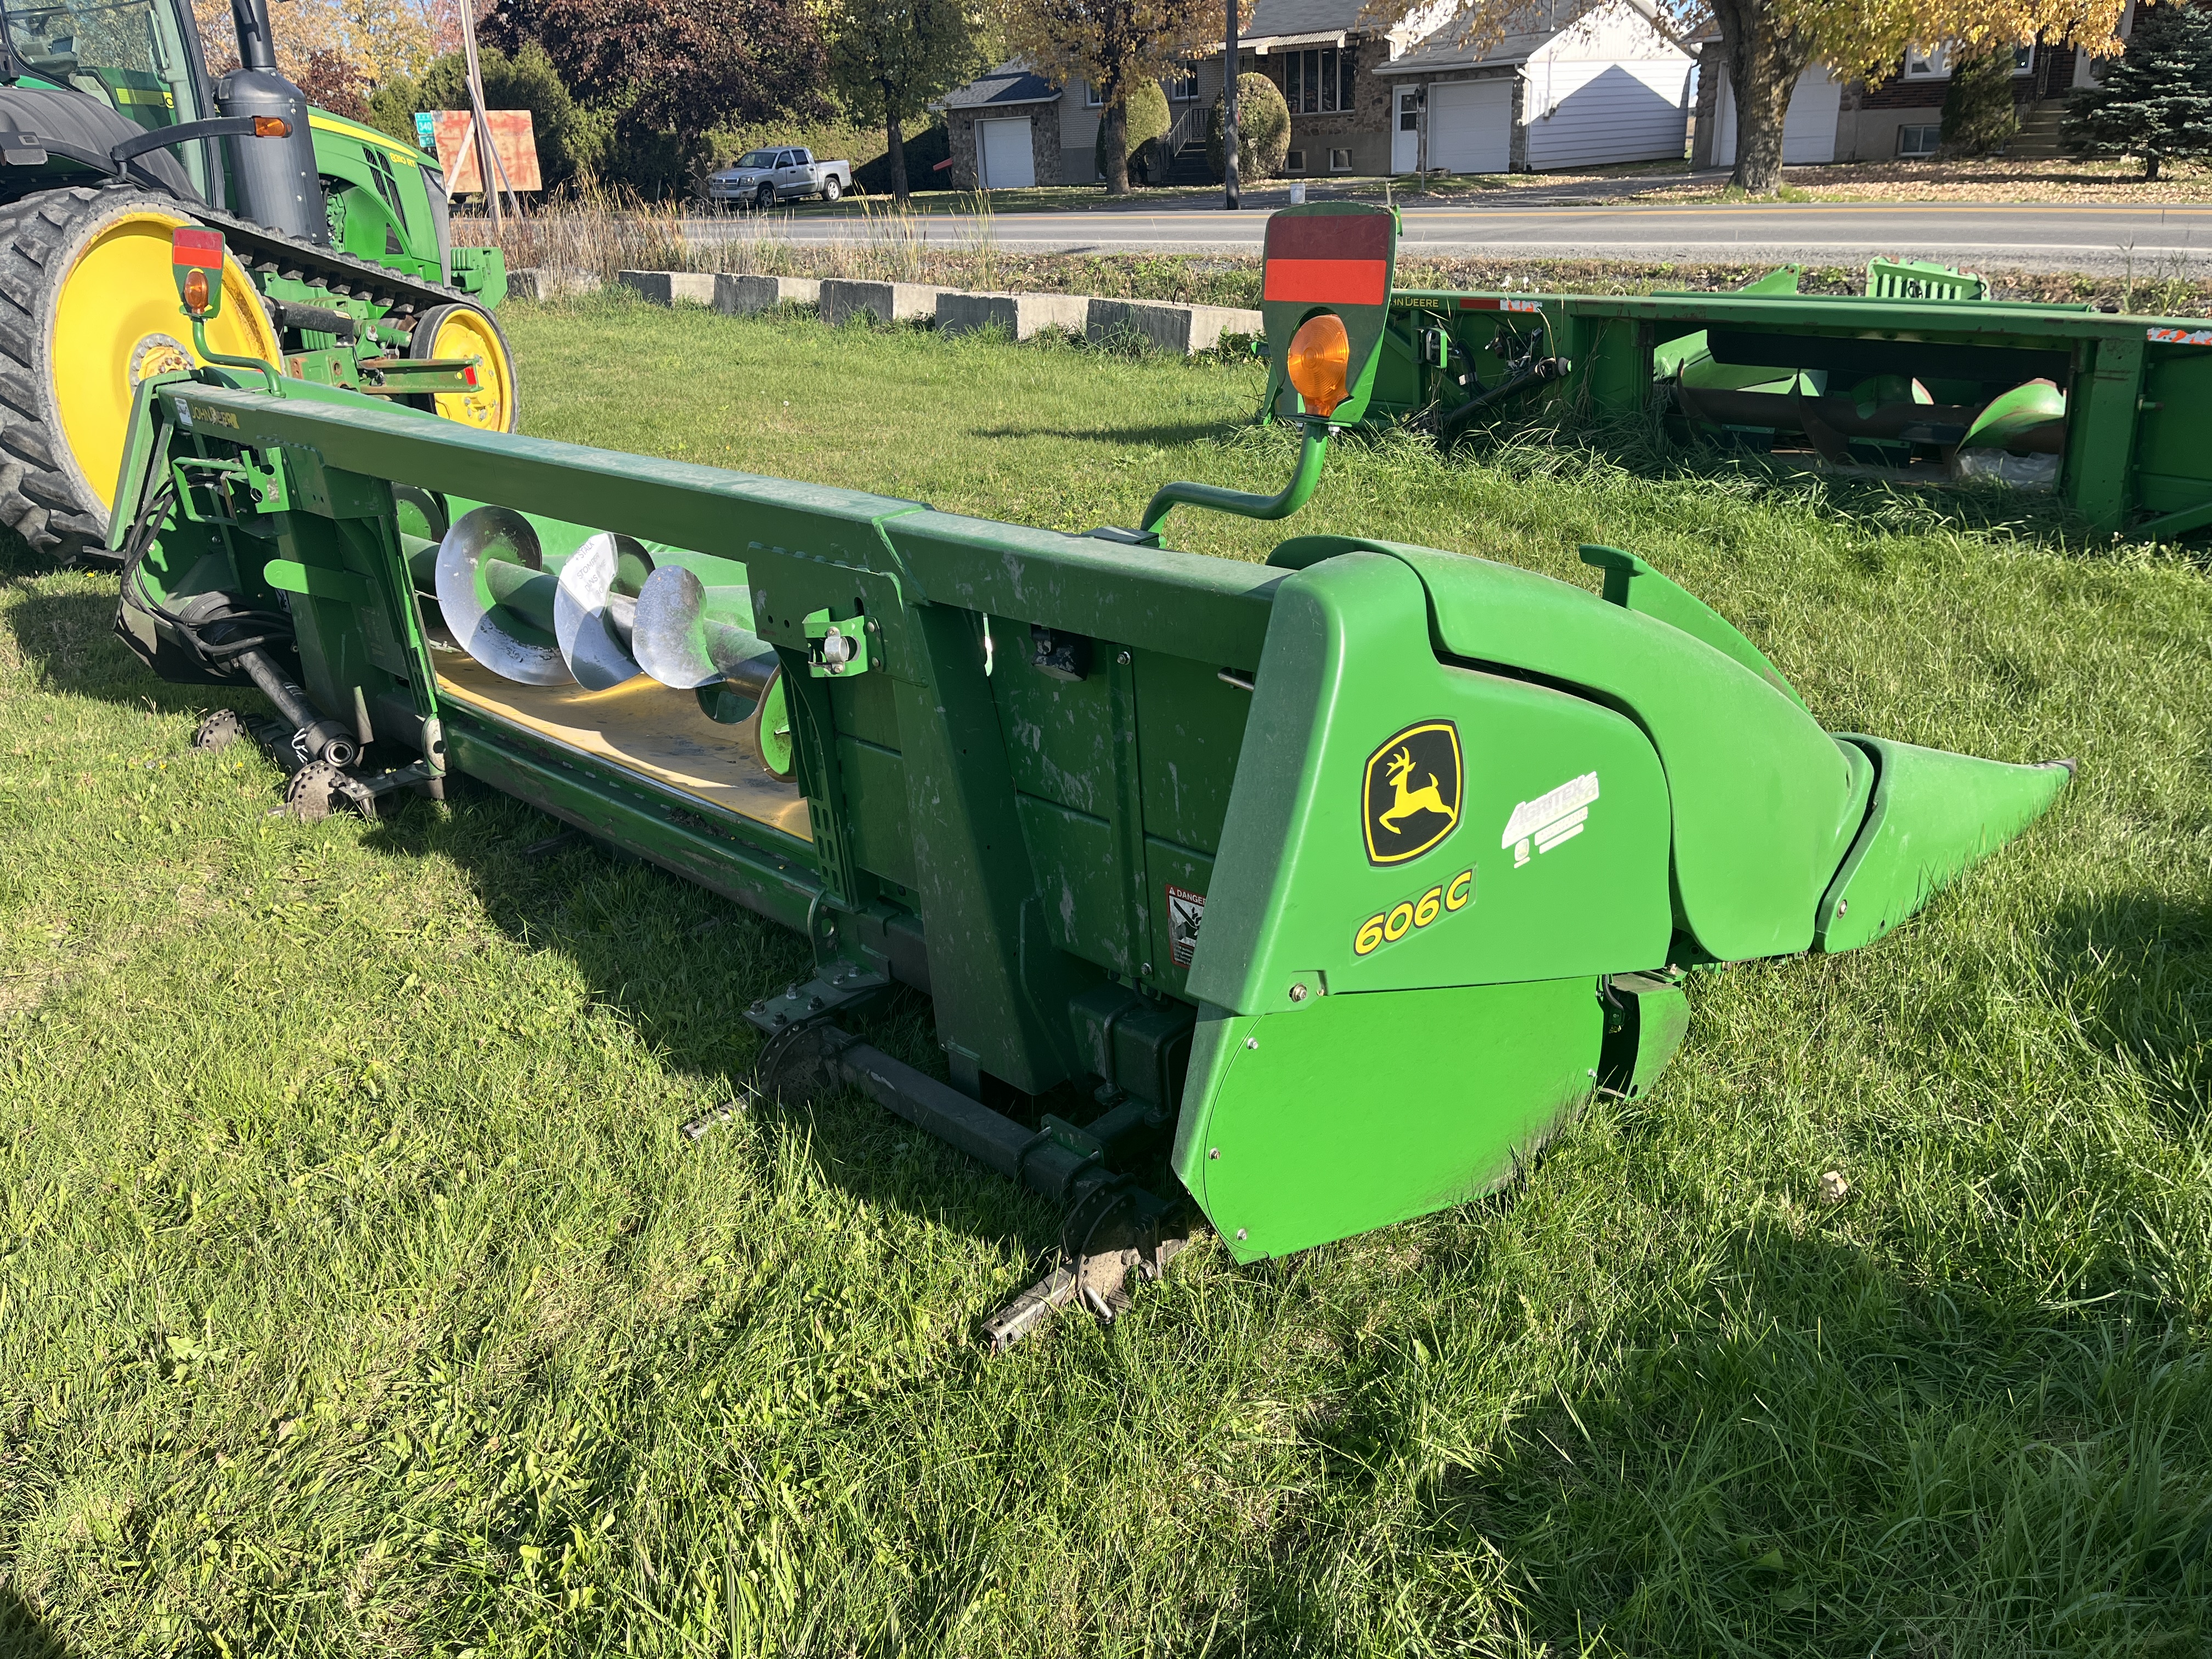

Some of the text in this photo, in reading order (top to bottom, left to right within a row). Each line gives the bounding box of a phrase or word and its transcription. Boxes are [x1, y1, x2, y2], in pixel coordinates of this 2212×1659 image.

[419, 122, 432, 131] 340
[406, 157, 416, 168] RT
[1405, 296, 1439, 307] DEERE
[191, 403, 213, 422] JOHN
